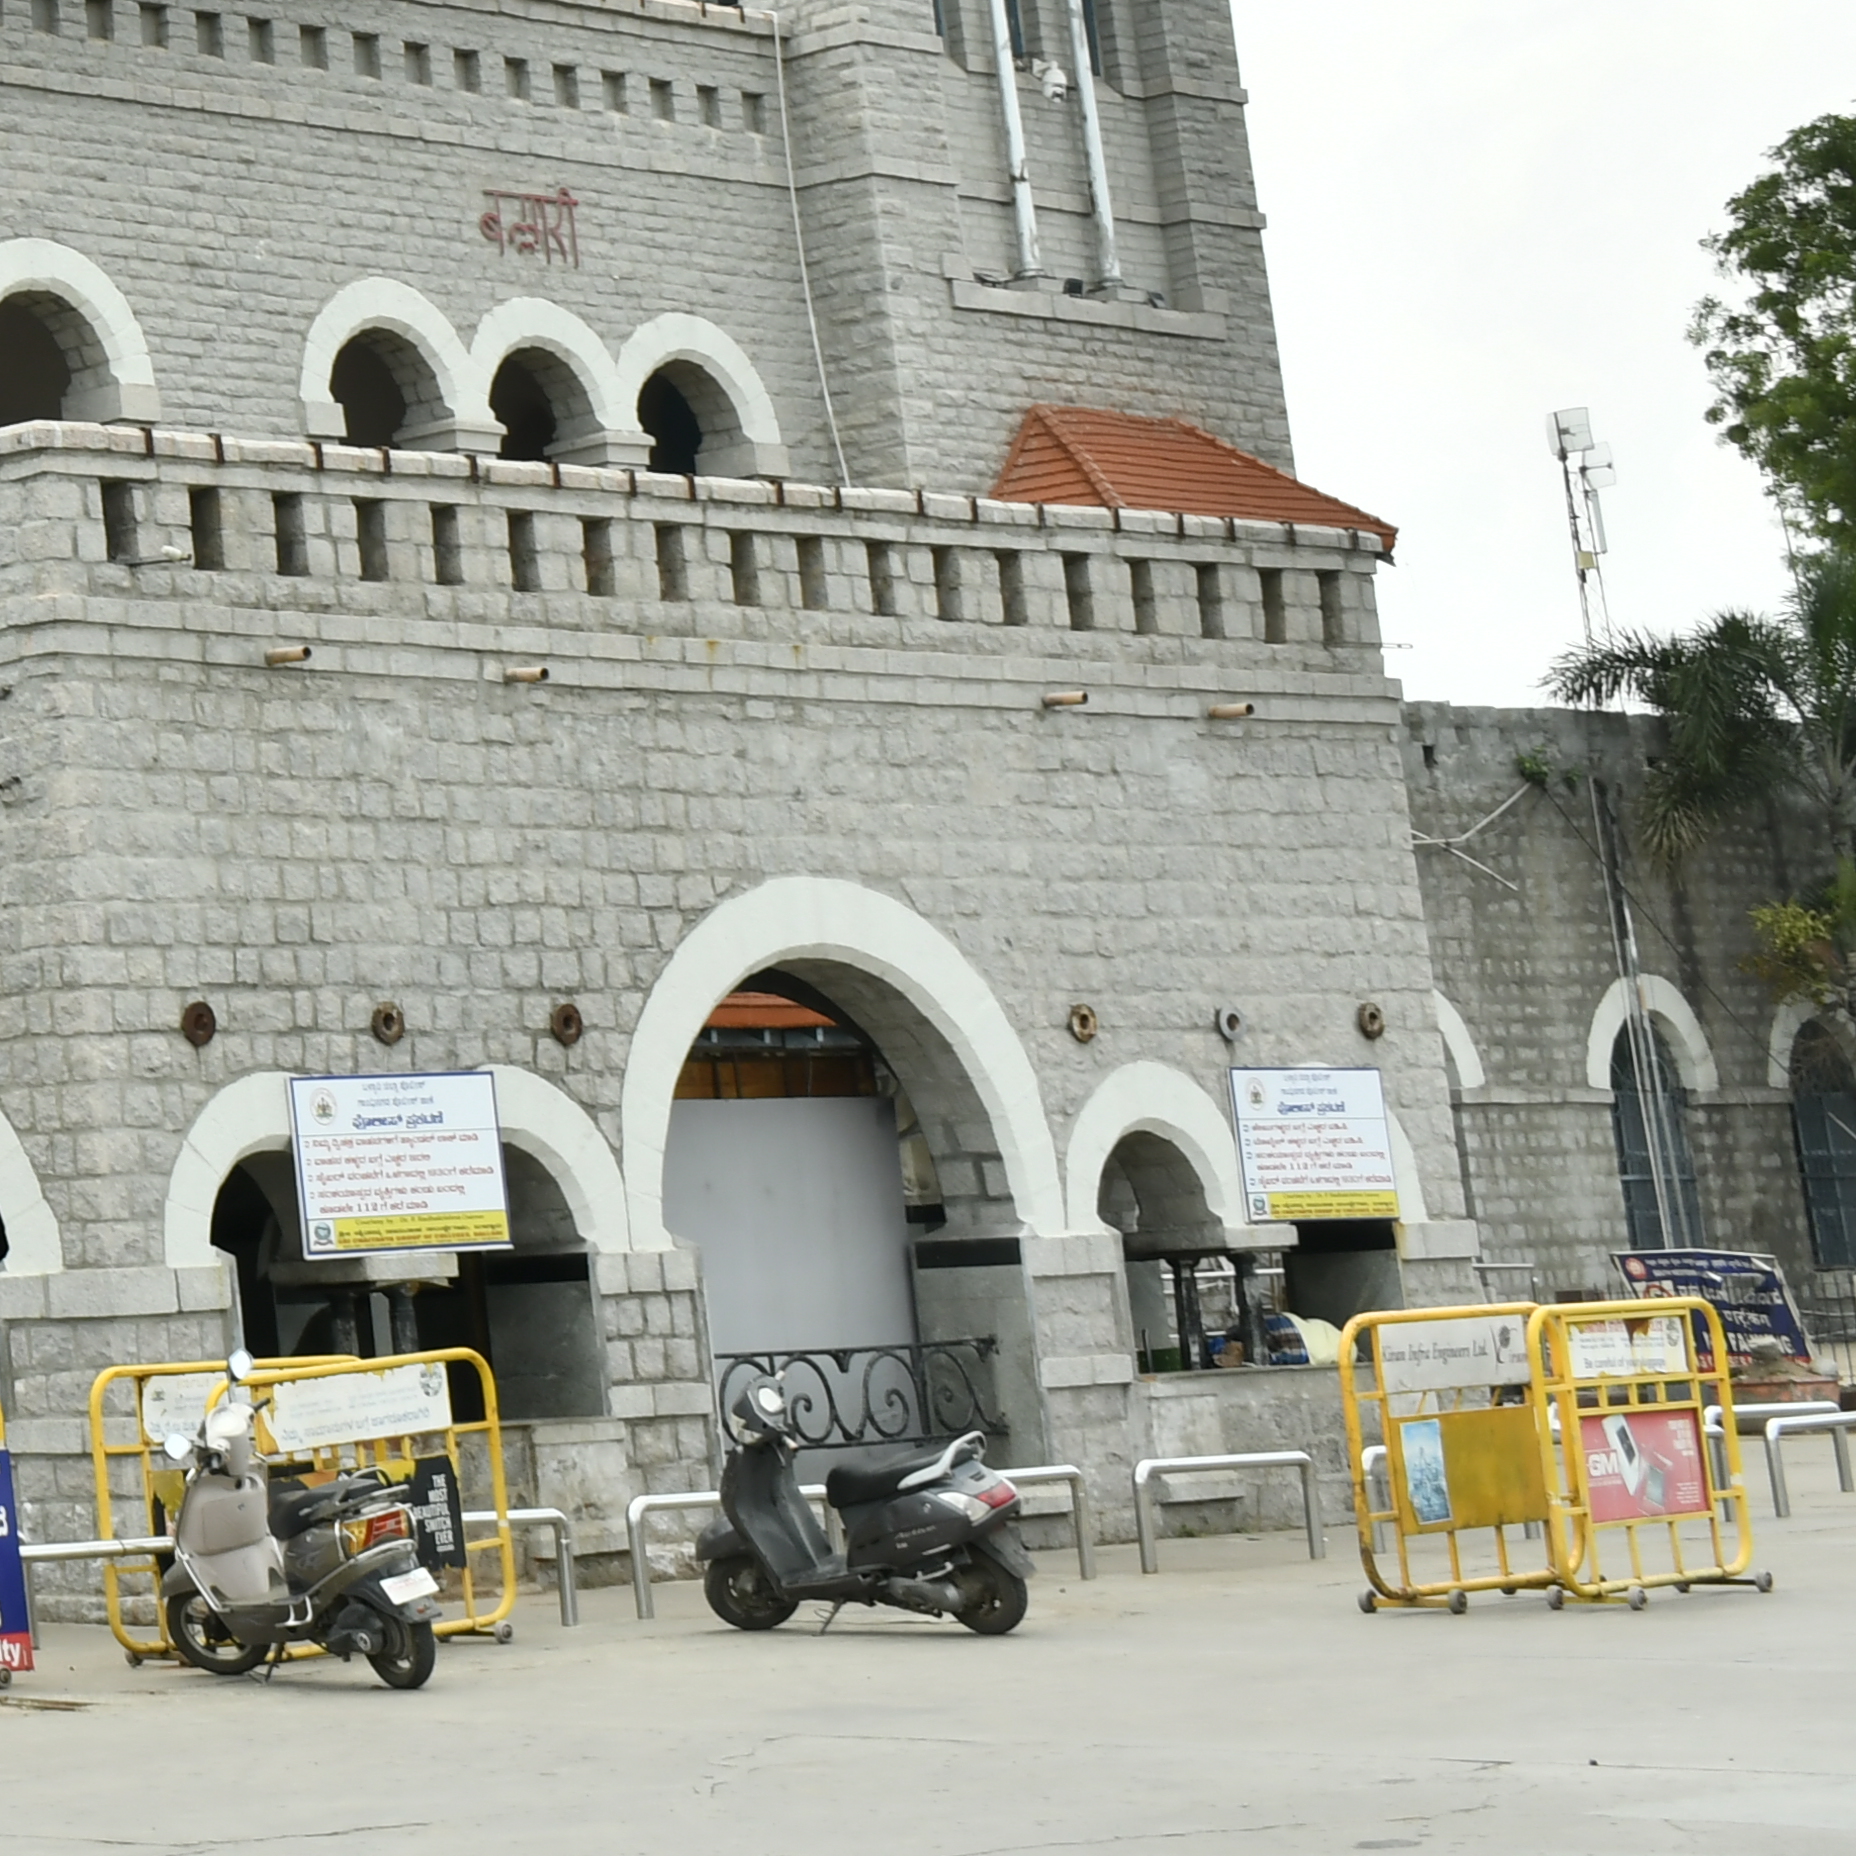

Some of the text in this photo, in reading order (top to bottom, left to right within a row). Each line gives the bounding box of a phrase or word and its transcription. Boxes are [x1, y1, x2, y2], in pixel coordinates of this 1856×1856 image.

[1587, 1451, 1619, 1477] GM
[431, 1473, 447, 1488] THE
[434, 1530, 454, 1545] EVER
